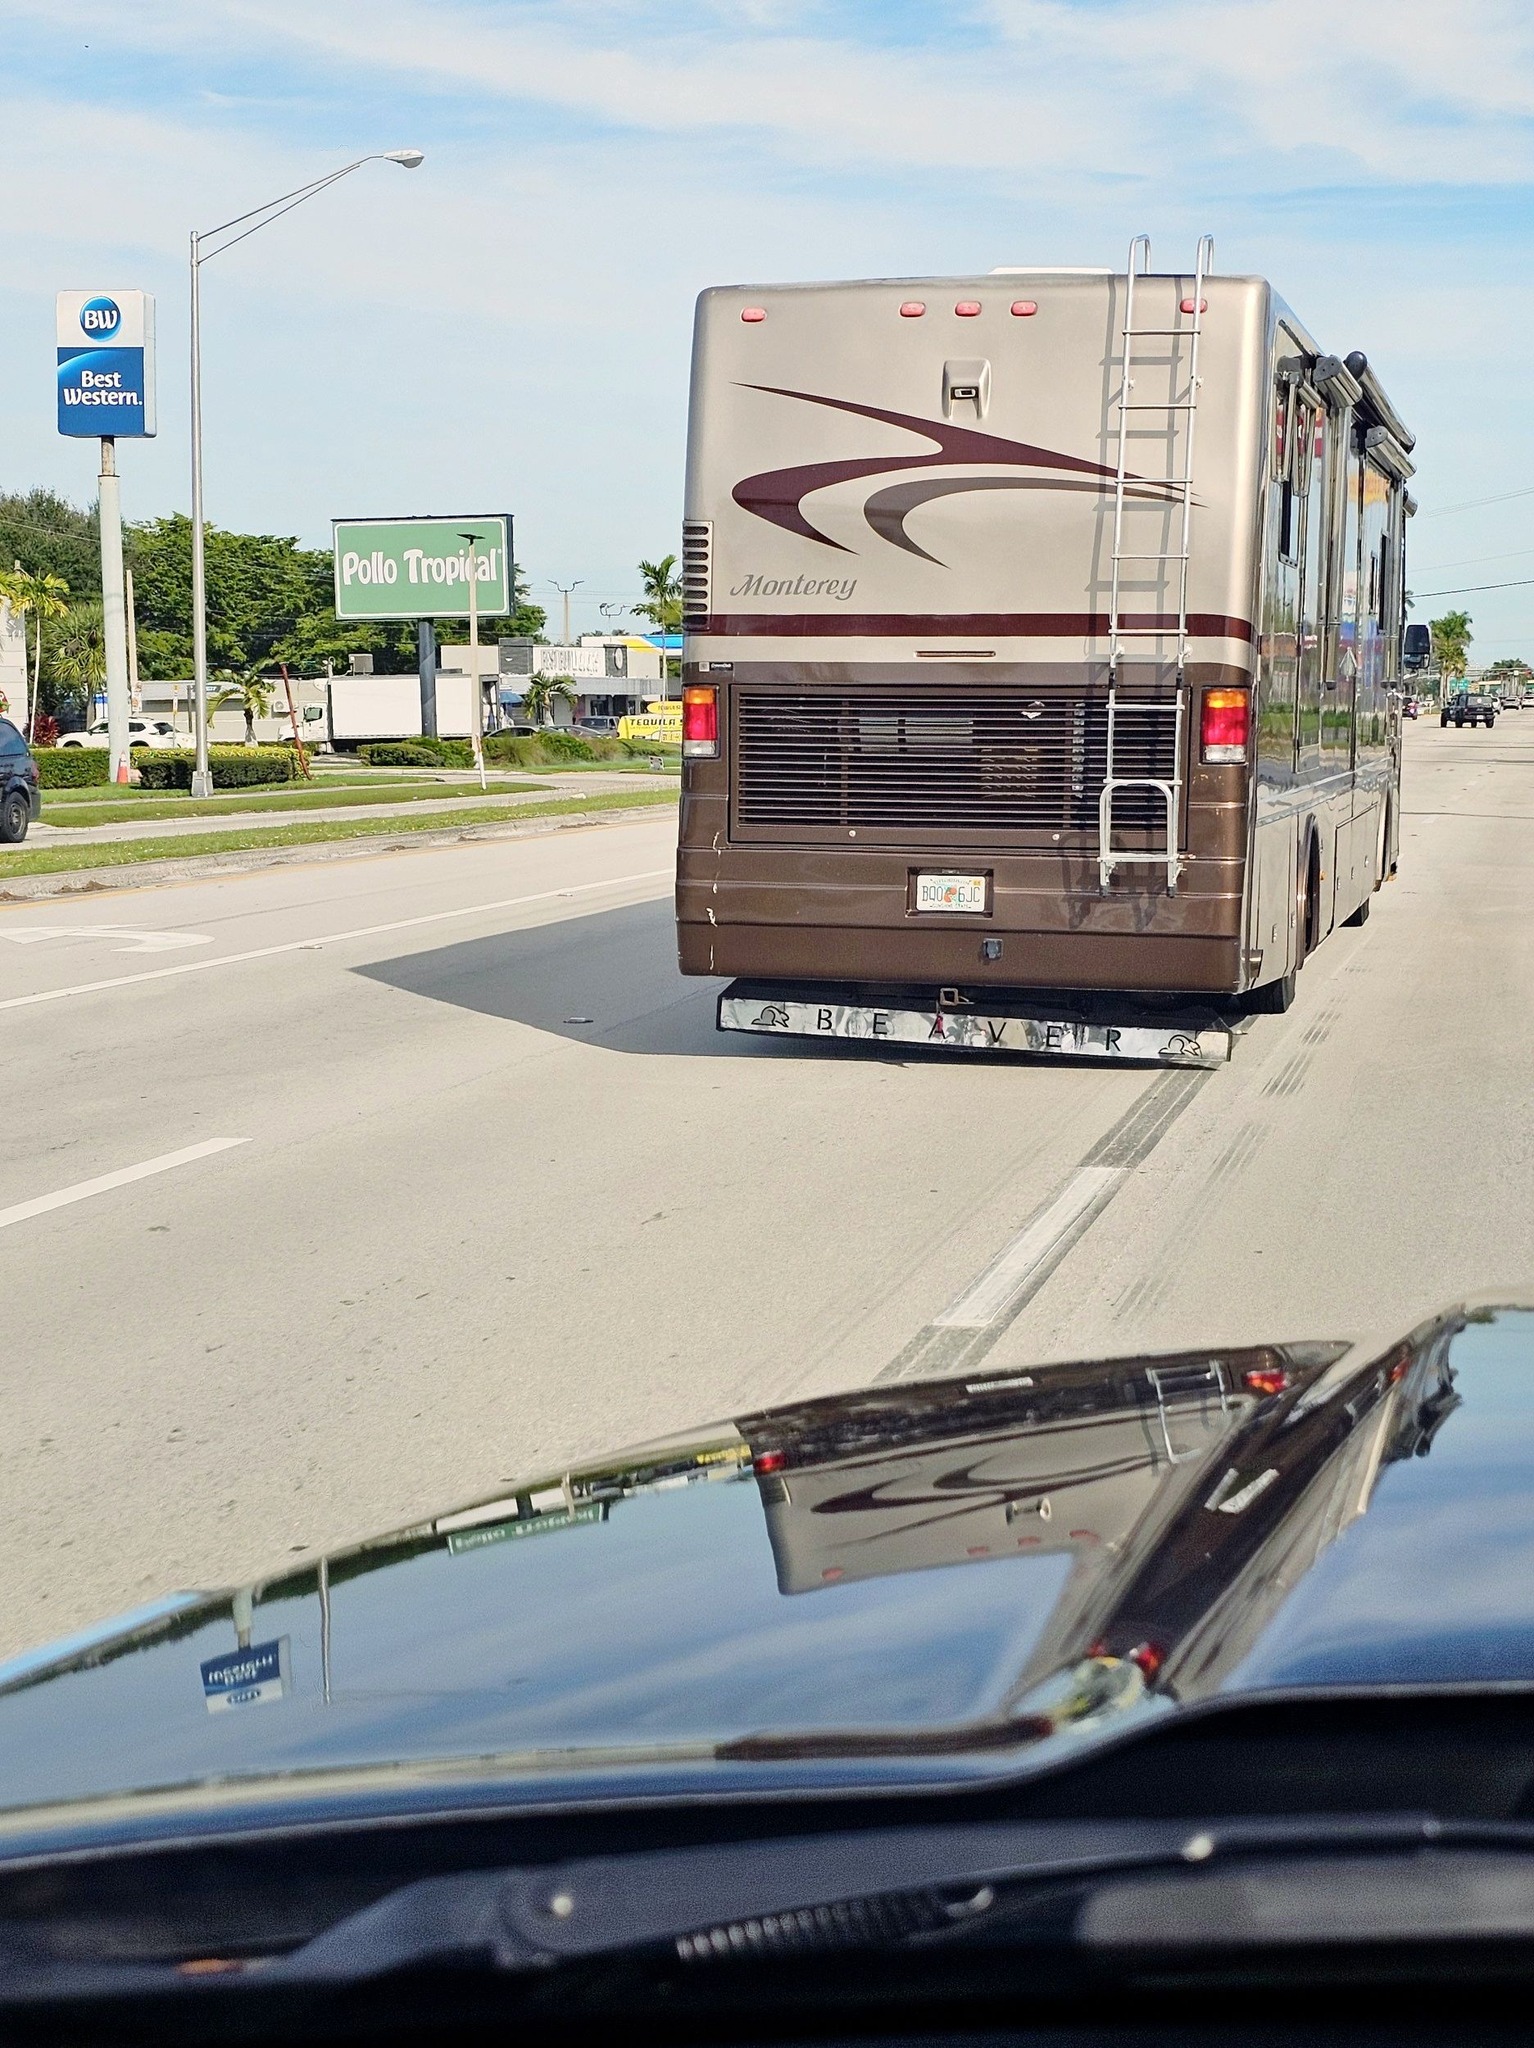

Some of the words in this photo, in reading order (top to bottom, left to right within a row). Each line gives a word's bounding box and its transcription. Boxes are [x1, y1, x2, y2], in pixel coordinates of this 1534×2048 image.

[84, 310, 118, 330] BW
[81, 370, 122, 388] Best
[342, 551, 398, 586] Pollo
[729, 573, 858, 601] Monterey
[629, 718, 676, 726] TEQUILA
